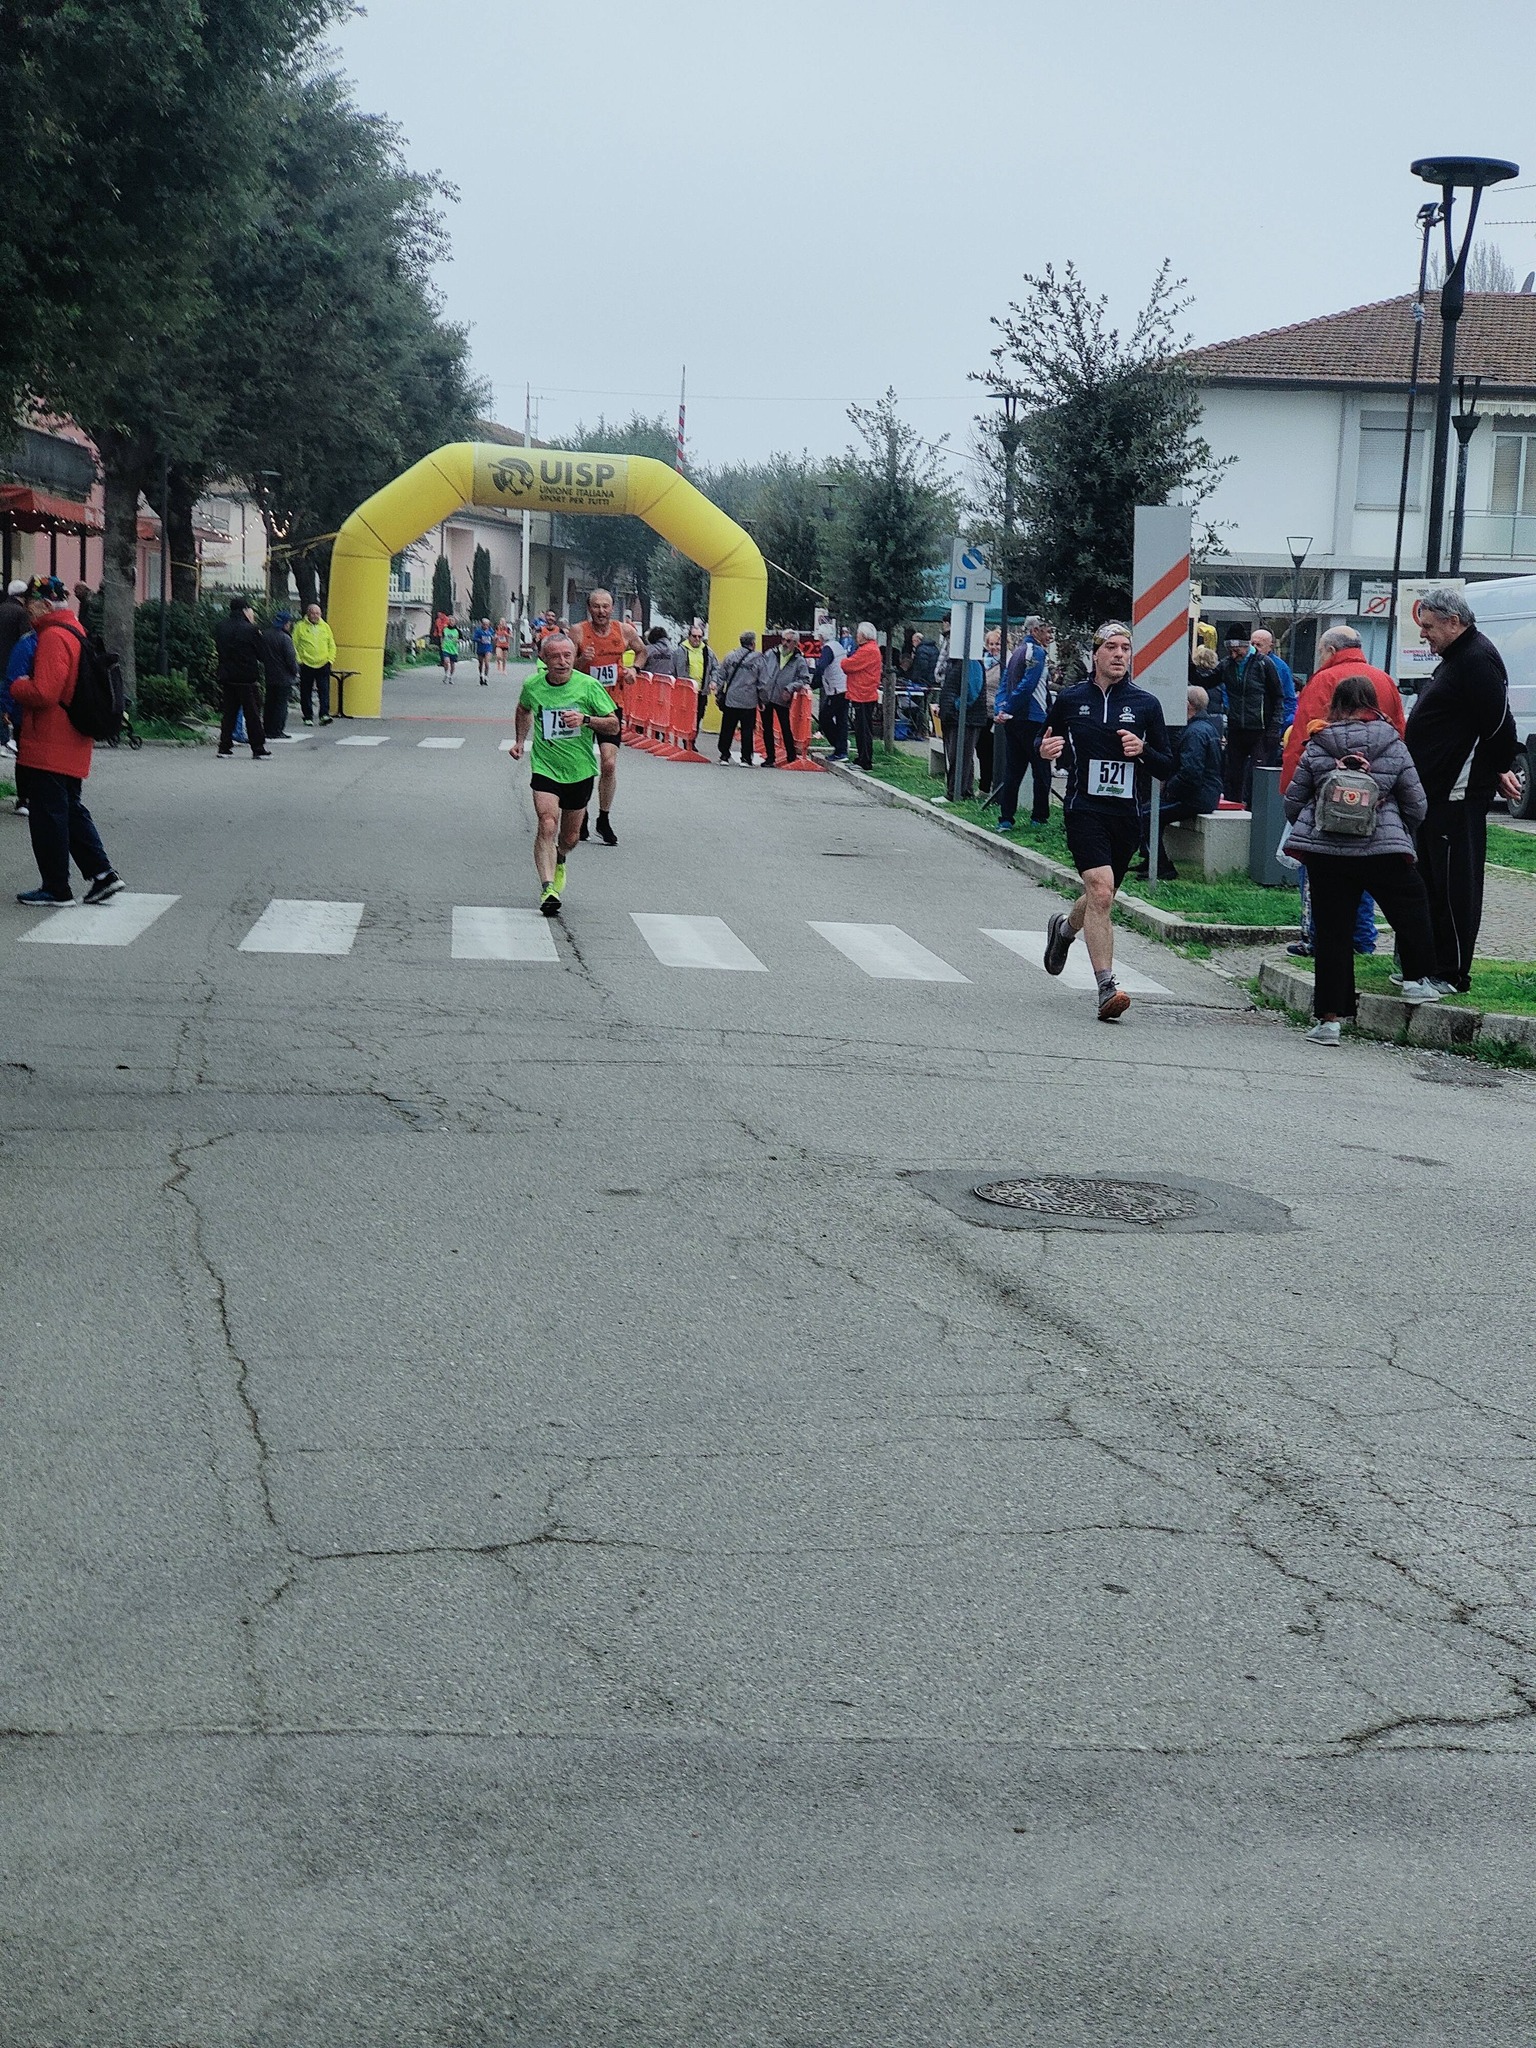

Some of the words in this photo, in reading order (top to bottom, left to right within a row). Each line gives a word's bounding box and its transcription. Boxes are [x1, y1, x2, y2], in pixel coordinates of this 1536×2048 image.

[540, 460, 615, 487] UISP
[540, 485, 573, 496] UNIONE
[576, 488, 615, 498] ITALIANA
[540, 494, 566, 503] SPORT
[570, 496, 584, 505] PER
[588, 497, 610, 505] TUTTI
[956, 579, 964, 588] P
[596, 665, 613, 680] 745
[551, 710, 573, 729] 73
[1100, 761, 1125, 785] 521
